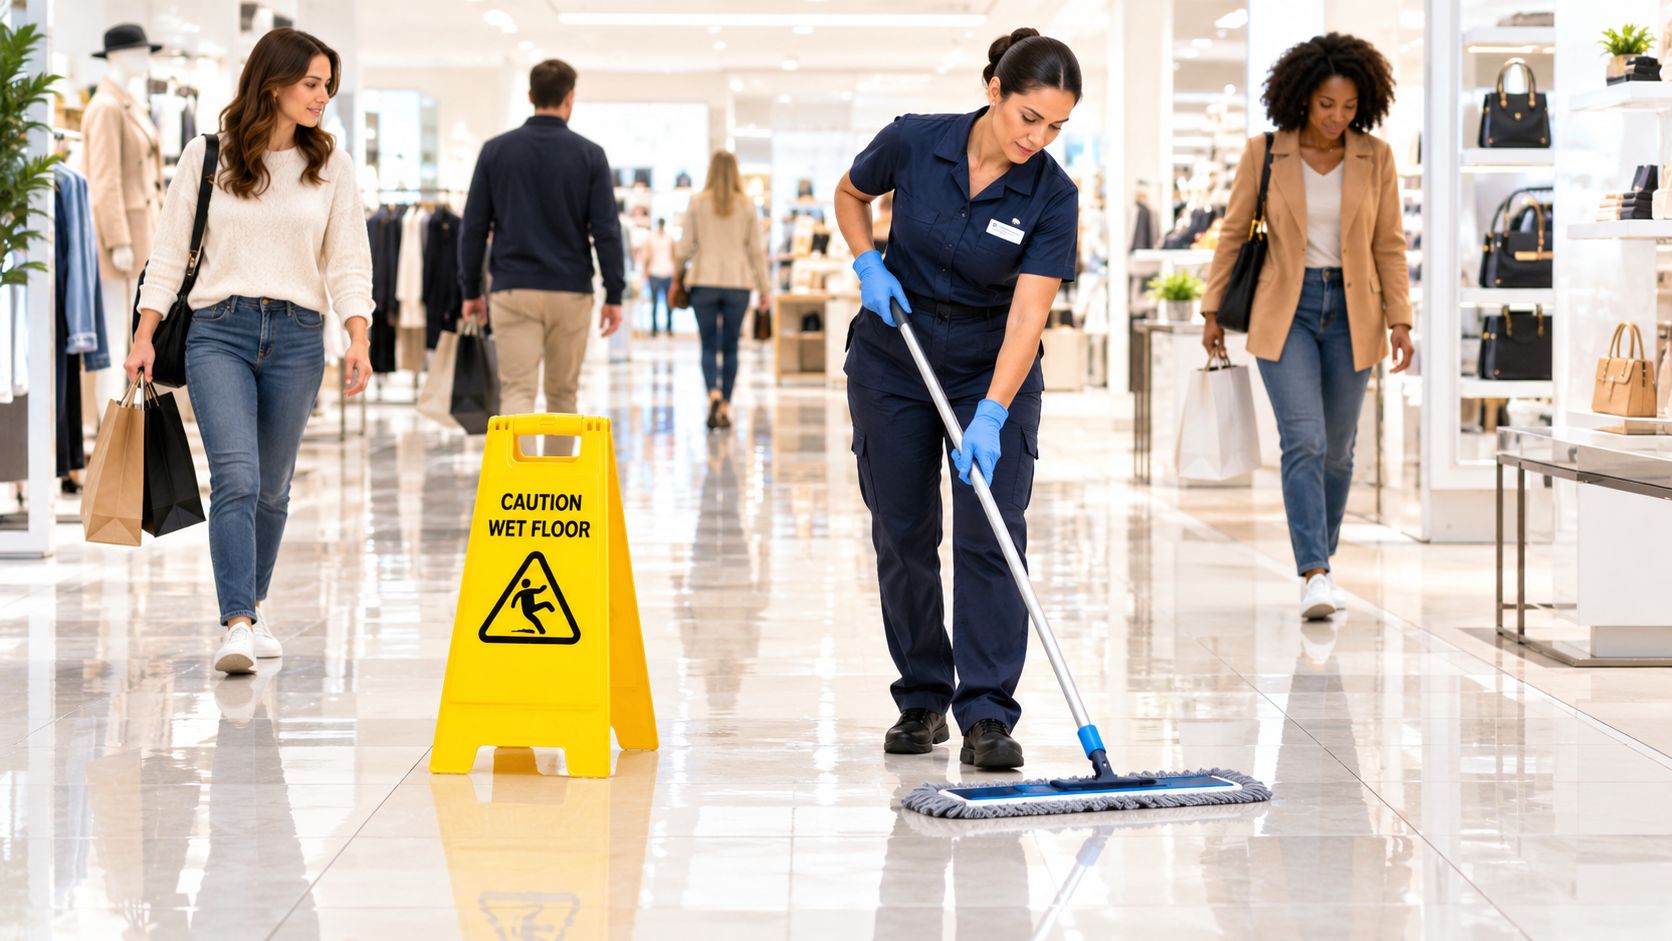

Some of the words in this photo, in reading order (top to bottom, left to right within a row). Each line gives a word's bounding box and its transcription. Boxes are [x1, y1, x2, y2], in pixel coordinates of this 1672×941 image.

[501, 493, 582, 511] CAUTION
[488, 519, 527, 537] WET
[531, 520, 591, 538] FLOOR
